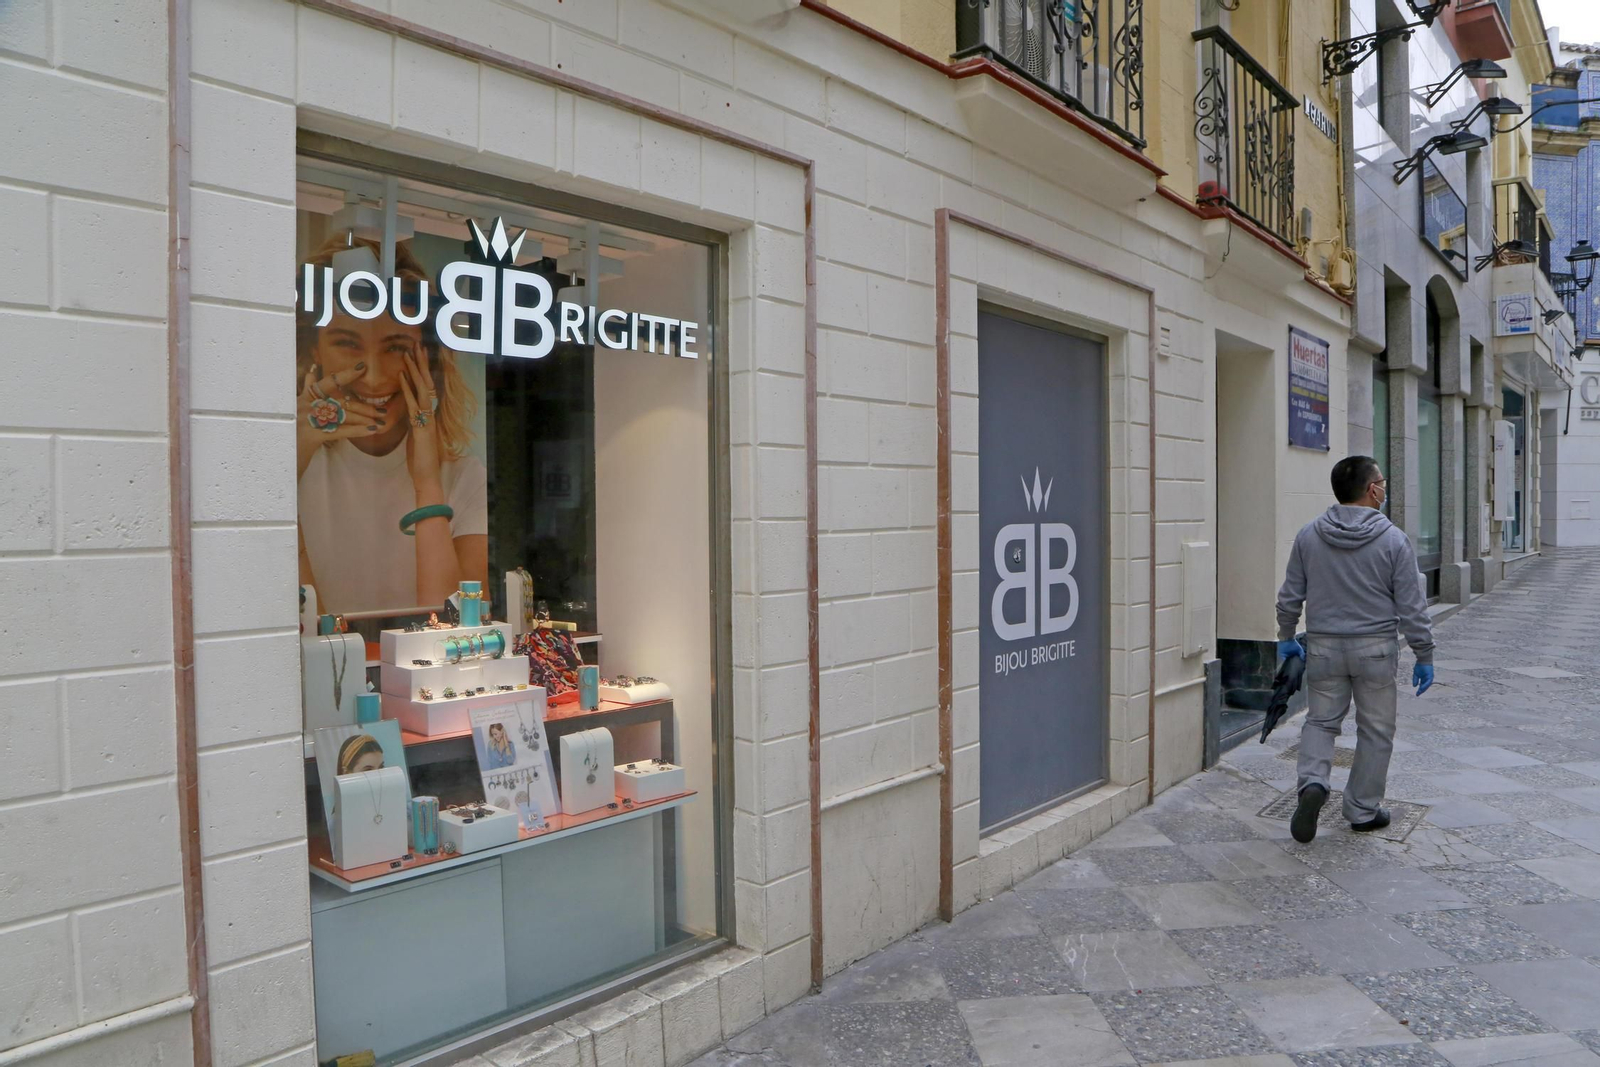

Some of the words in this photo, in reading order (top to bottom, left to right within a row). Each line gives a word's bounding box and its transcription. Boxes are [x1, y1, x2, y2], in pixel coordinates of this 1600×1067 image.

[294, 263, 429, 327] IJOU
[1293, 335, 1326, 370] Huertas
[995, 649, 1028, 676] BIJOU
[1031, 640, 1076, 665] BRIGITTE
